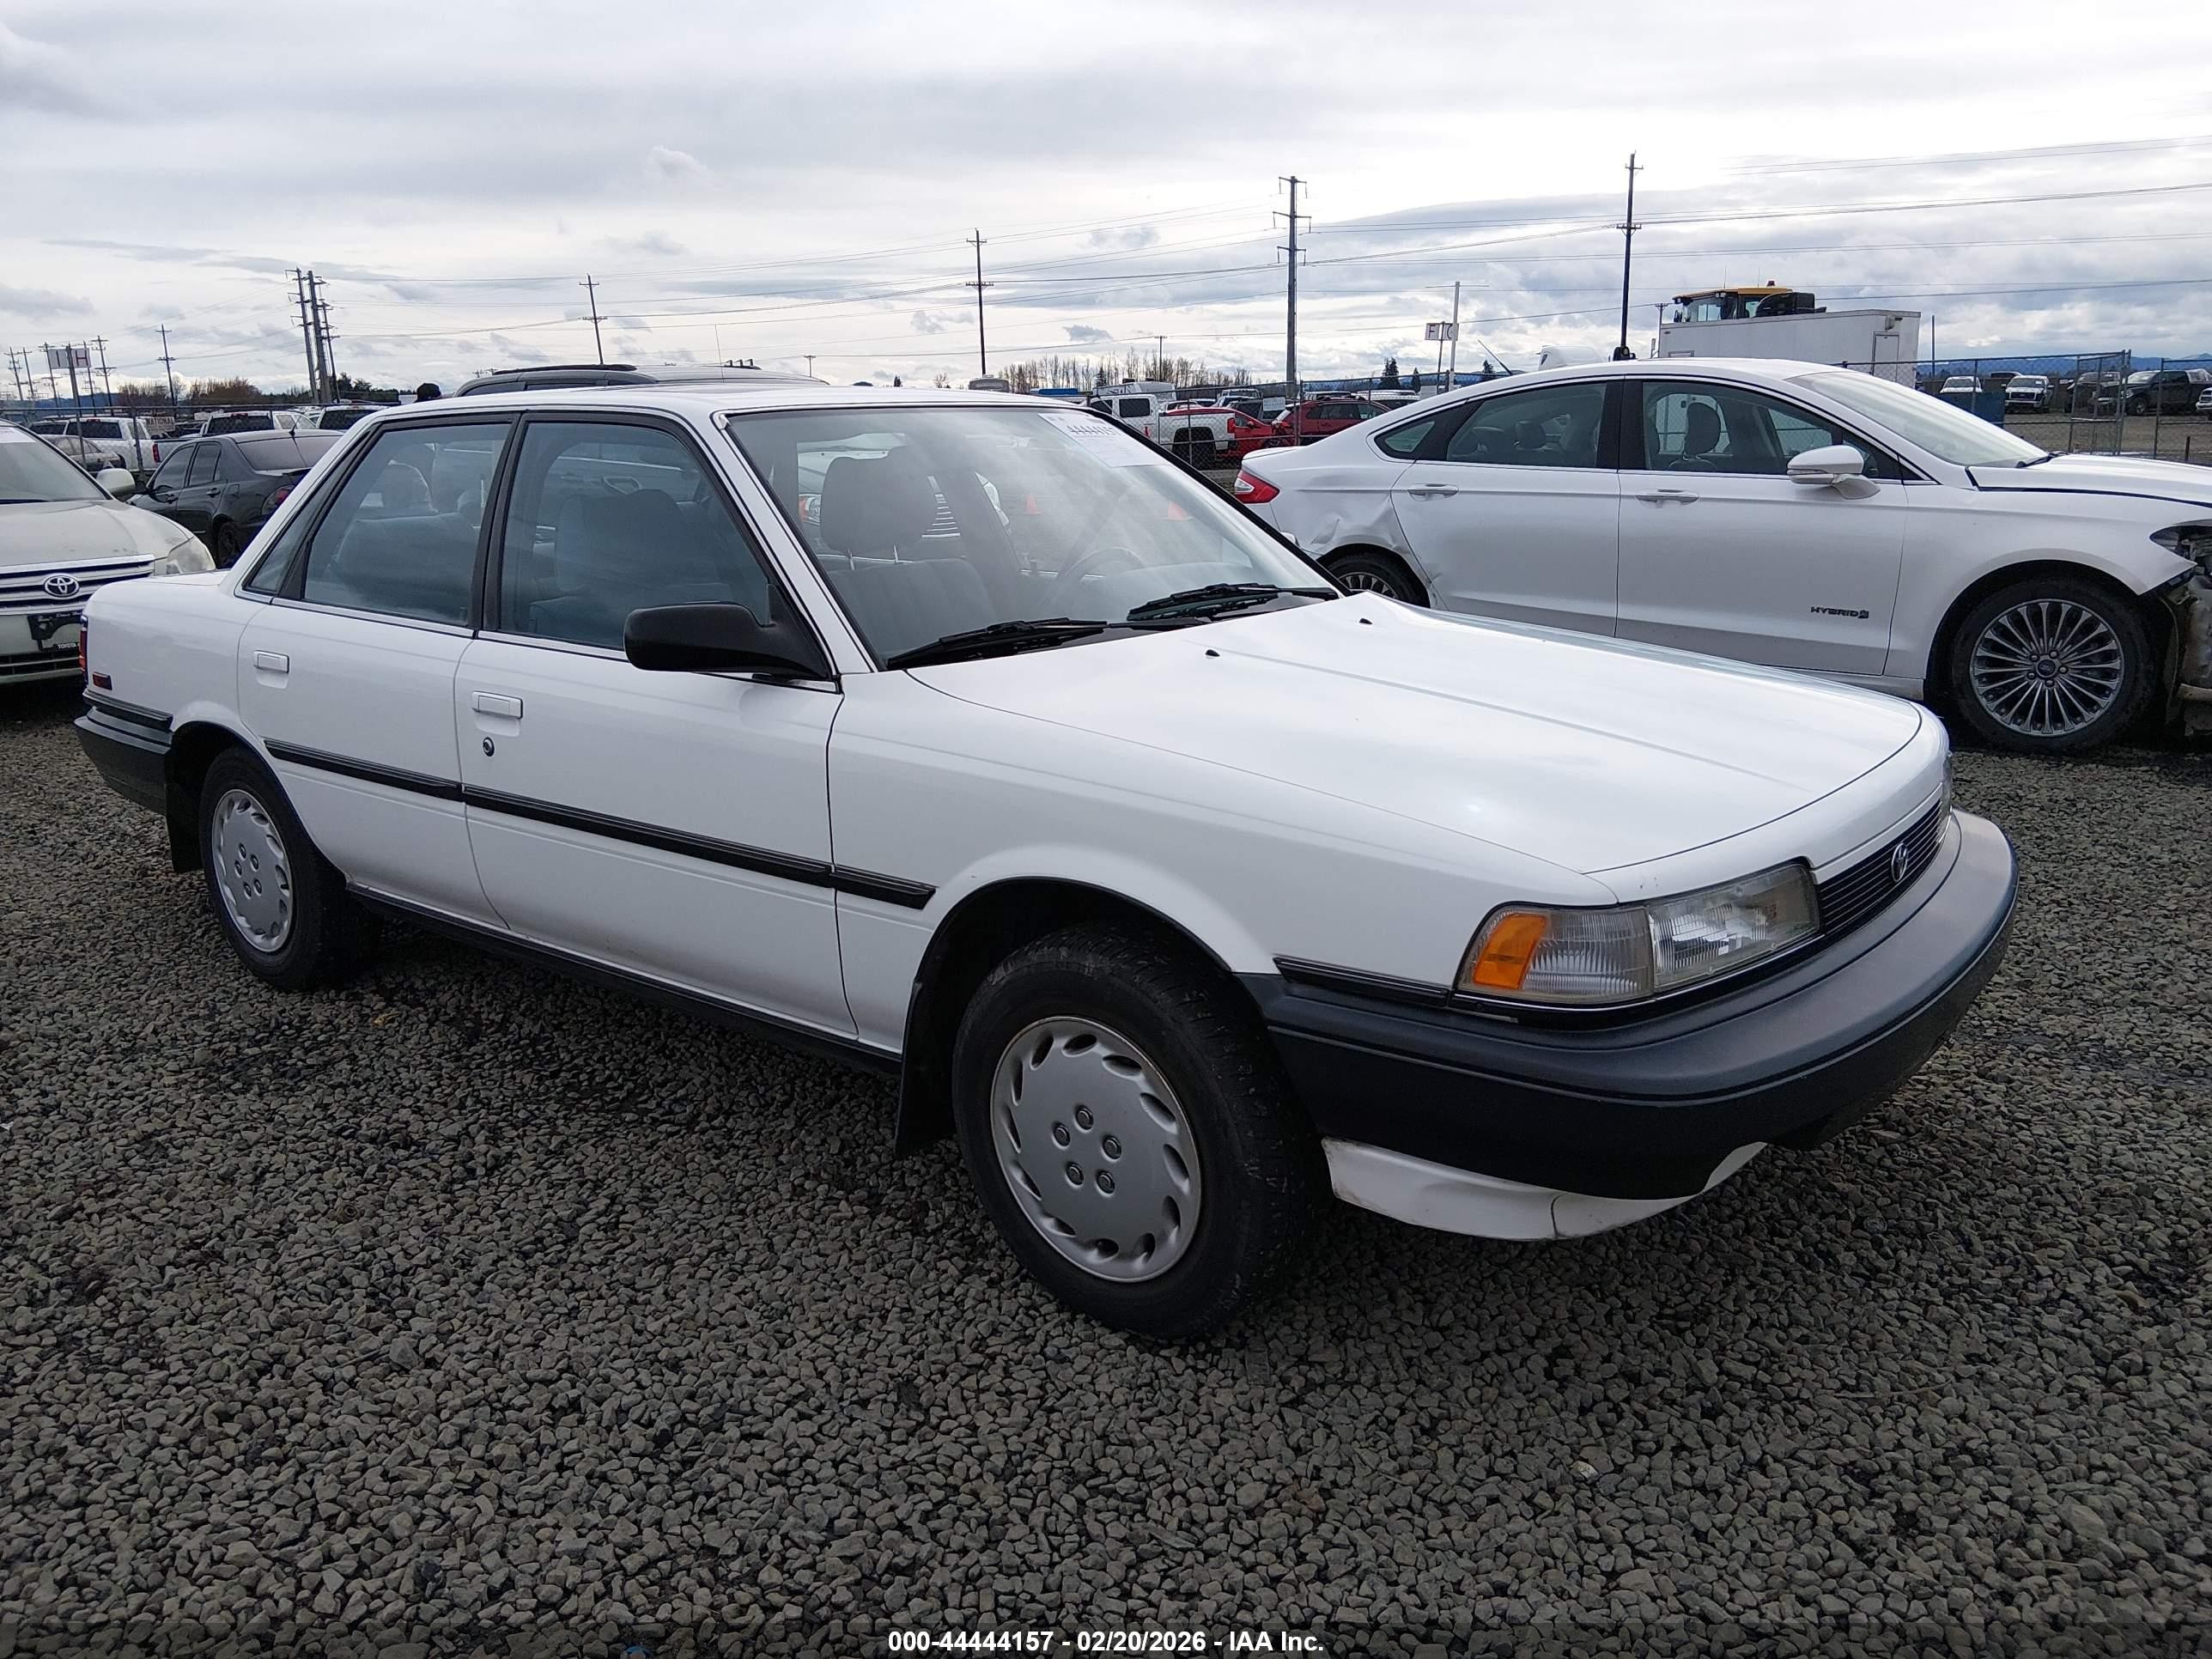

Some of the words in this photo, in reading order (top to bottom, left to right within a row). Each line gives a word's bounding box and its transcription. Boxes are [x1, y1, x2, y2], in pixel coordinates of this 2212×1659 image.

[75, 349, 88, 367] H
[147, 416, 174, 425] NATIONAL
[1811, 606, 1859, 617] HYBRID
